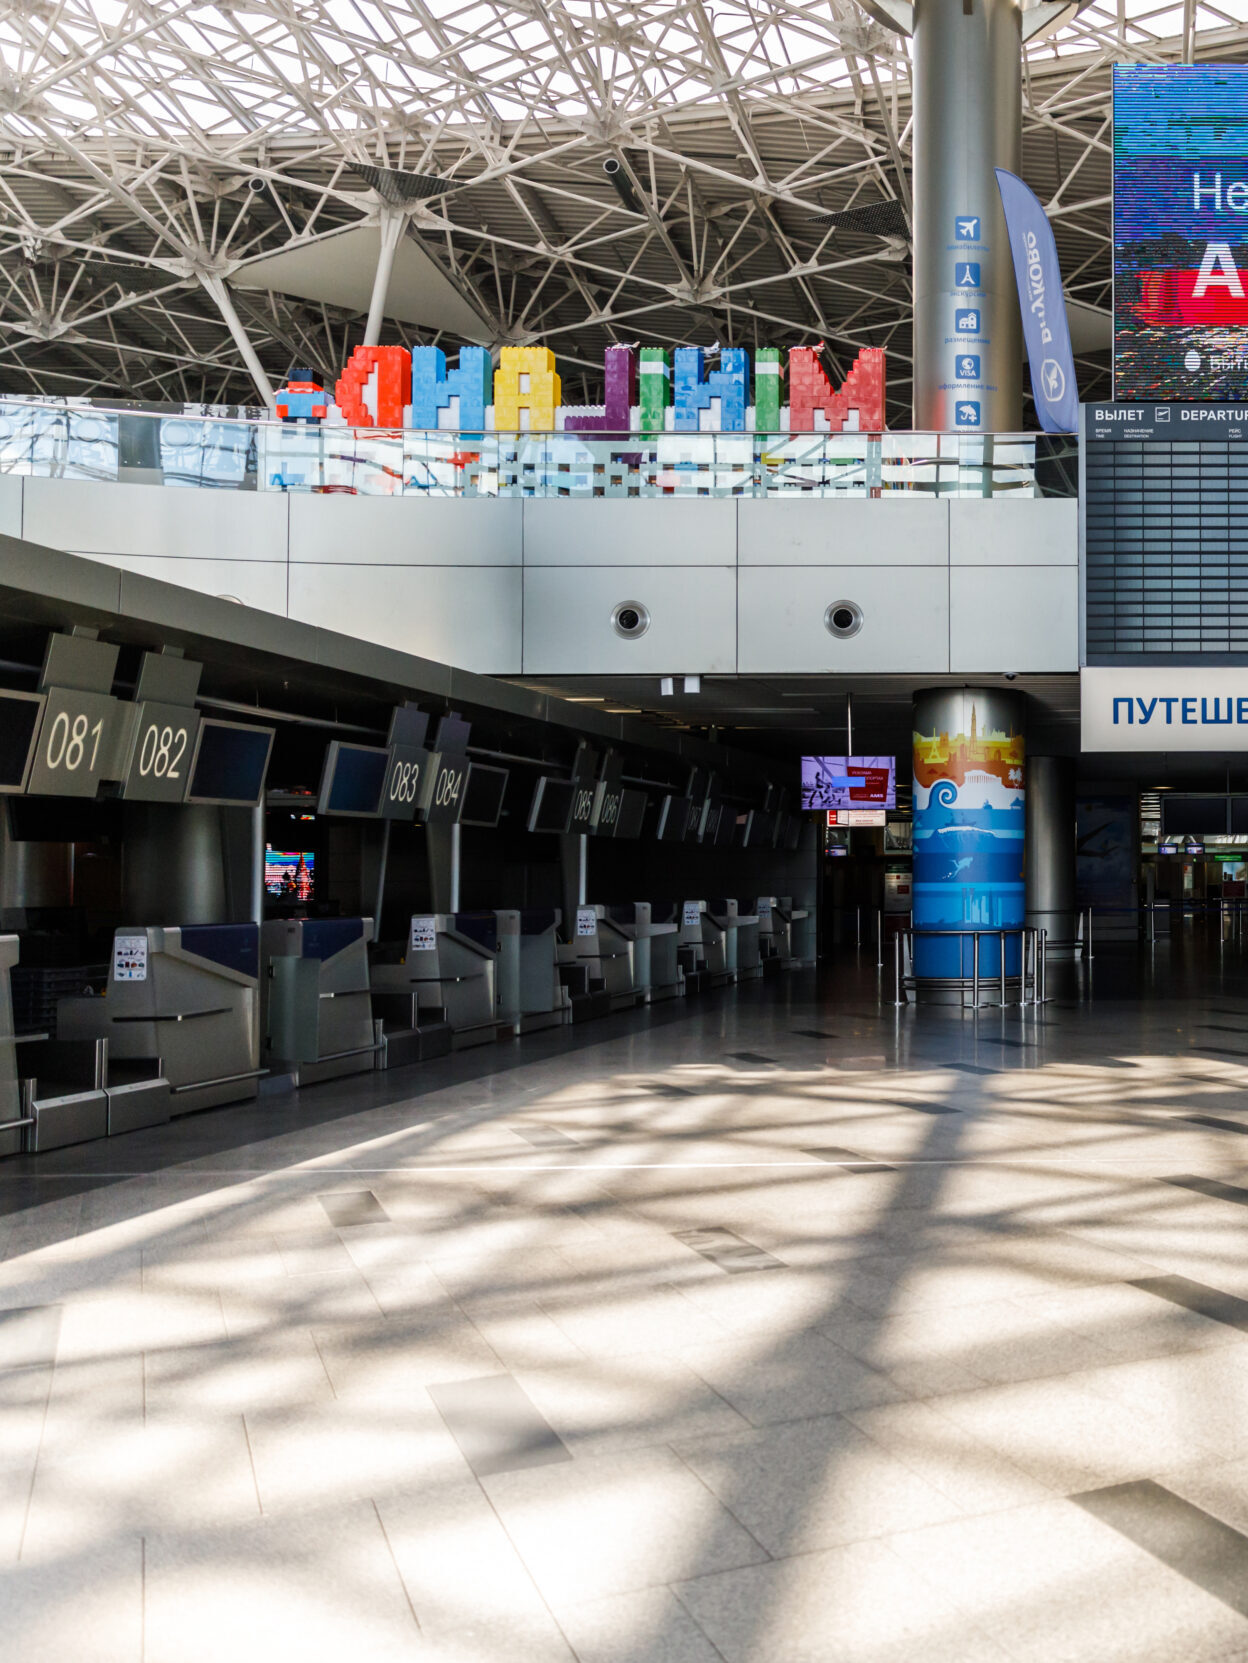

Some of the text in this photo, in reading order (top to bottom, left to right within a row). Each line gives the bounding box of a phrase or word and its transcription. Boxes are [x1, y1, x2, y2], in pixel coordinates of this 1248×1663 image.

[1191, 243, 1246, 299] А
[1095, 409, 1144, 421] ВЫЛЕТ
[46, 711, 105, 771] 081
[138, 723, 188, 780] 082
[389, 760, 419, 803] 083
[435, 768, 460, 808] 084
[573, 789, 593, 821] 085
[600, 795, 620, 825] 086
